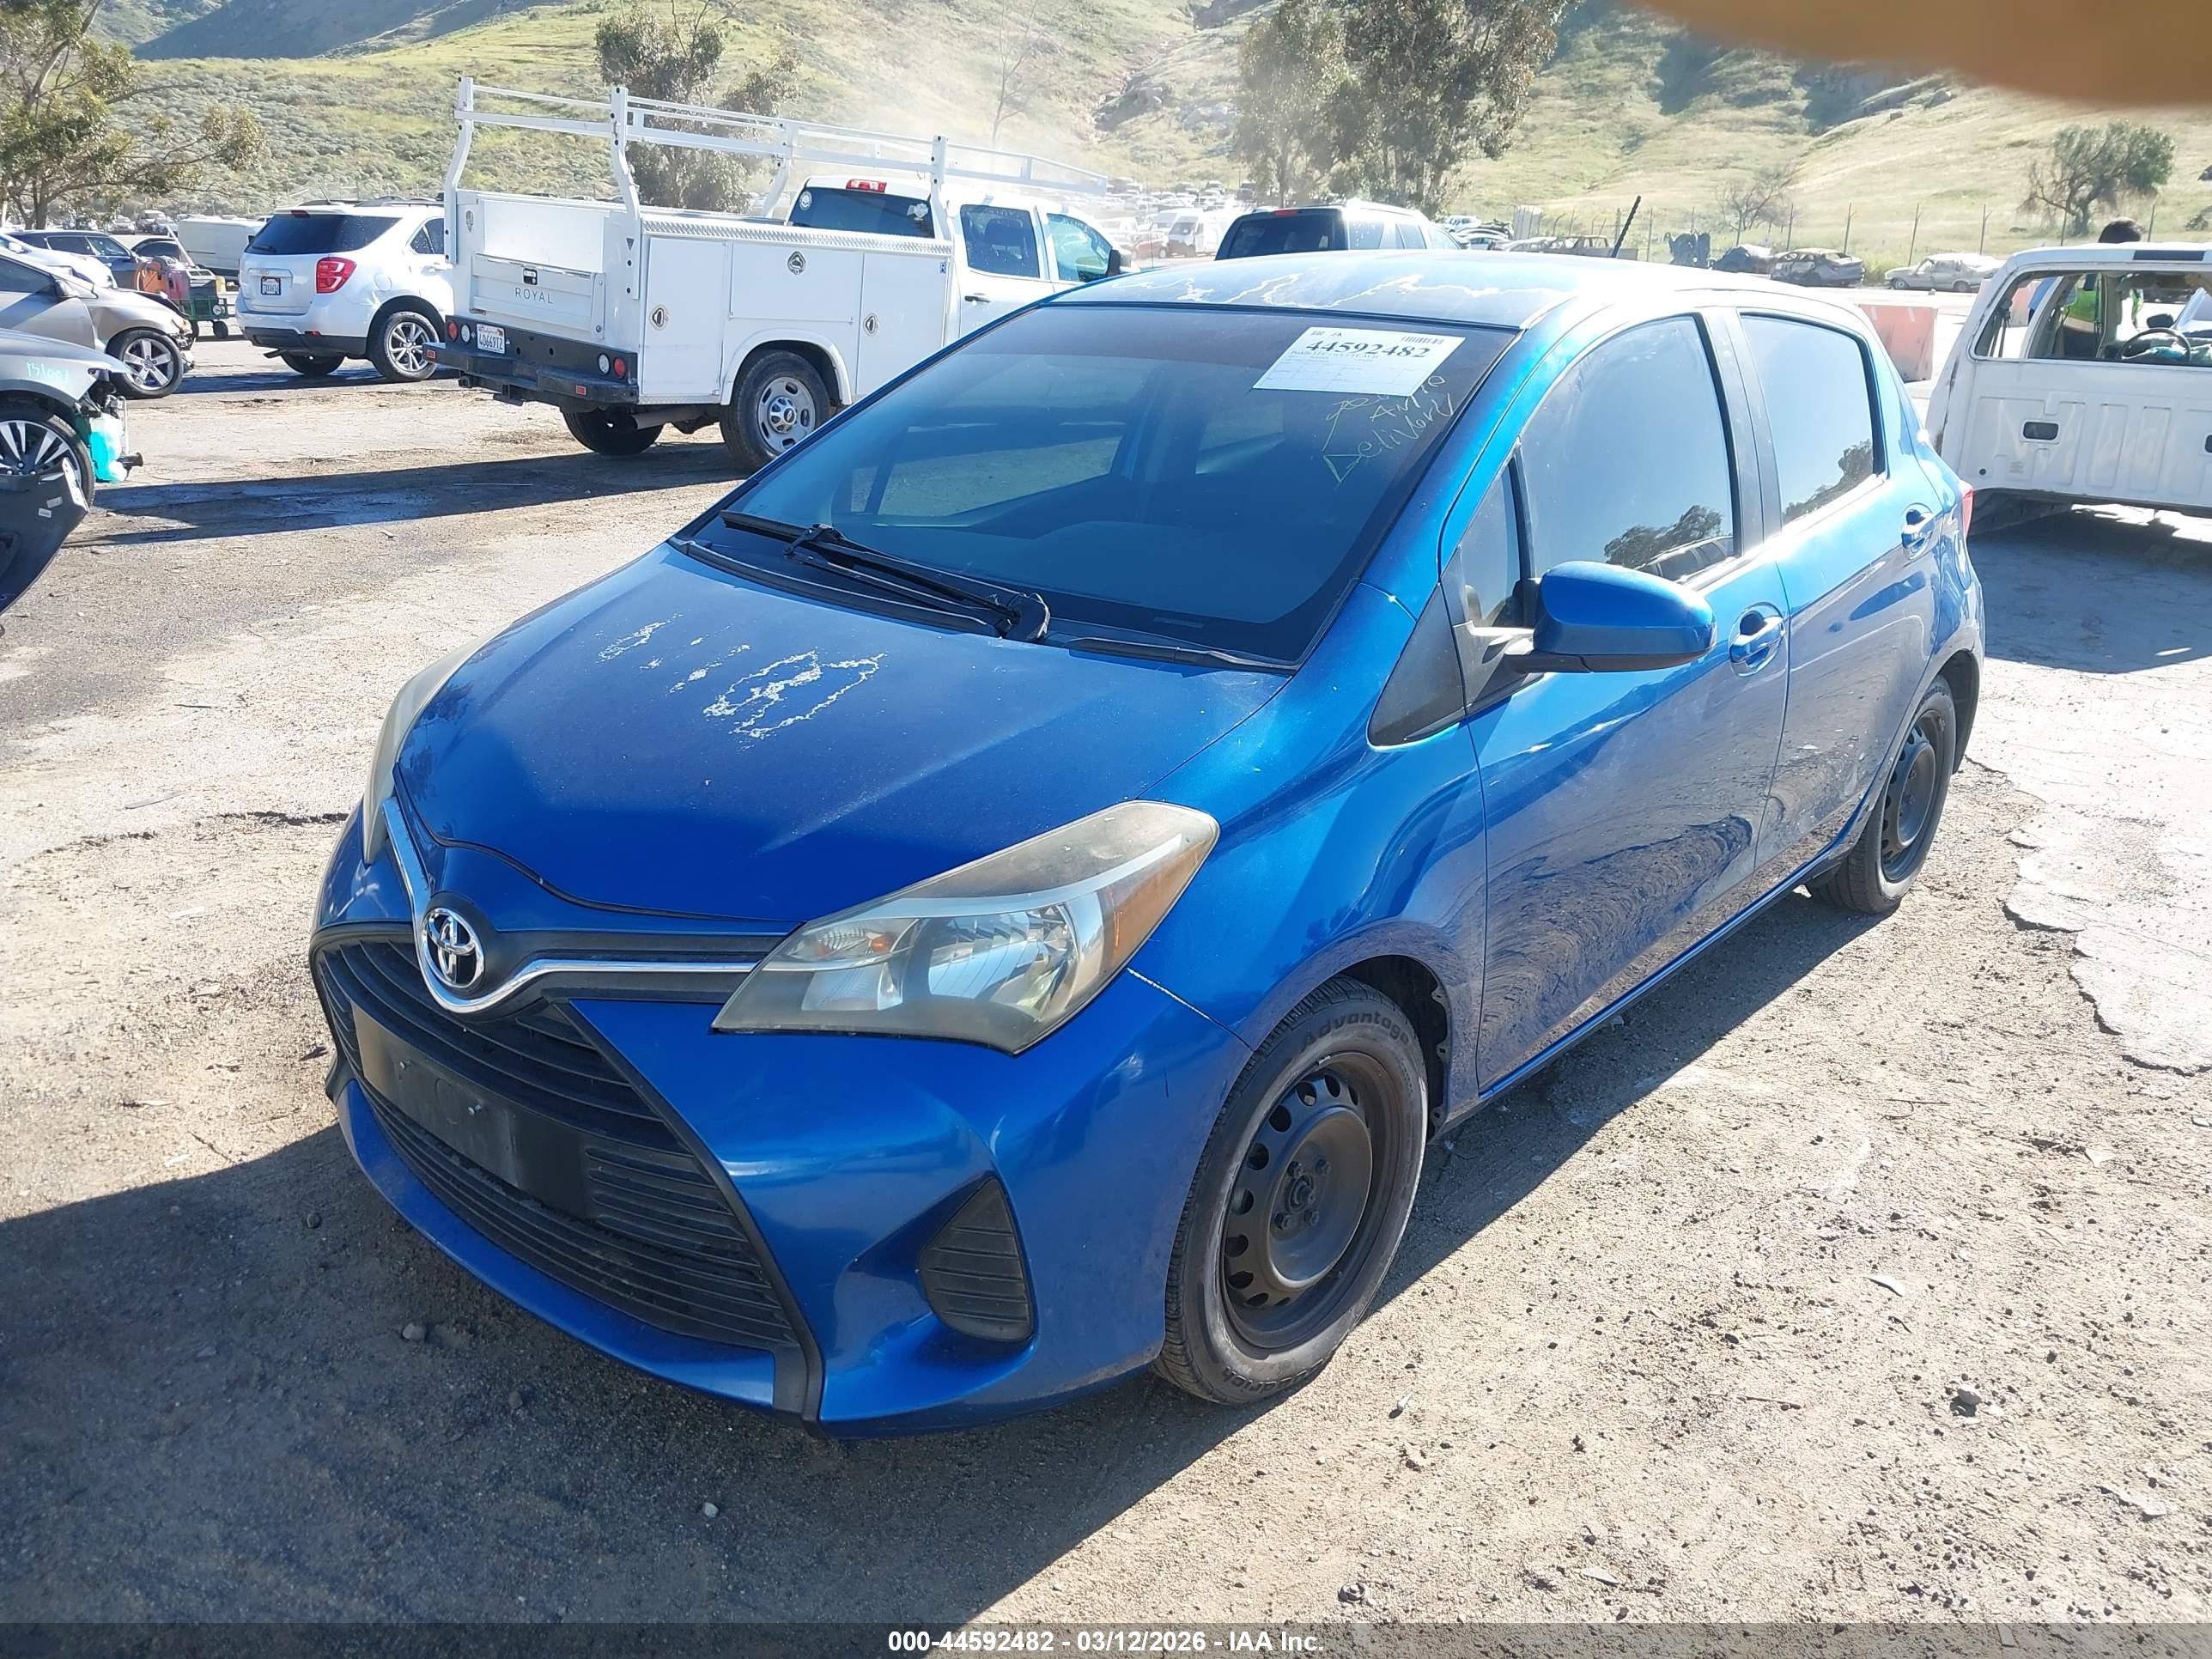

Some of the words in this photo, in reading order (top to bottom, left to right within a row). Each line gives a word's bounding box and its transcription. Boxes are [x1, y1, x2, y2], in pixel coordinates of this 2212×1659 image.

[514, 287, 554, 304] ROYAL
[1305, 339, 1431, 358] 44592482
[1300, 1012, 1410, 1051] Advantage
